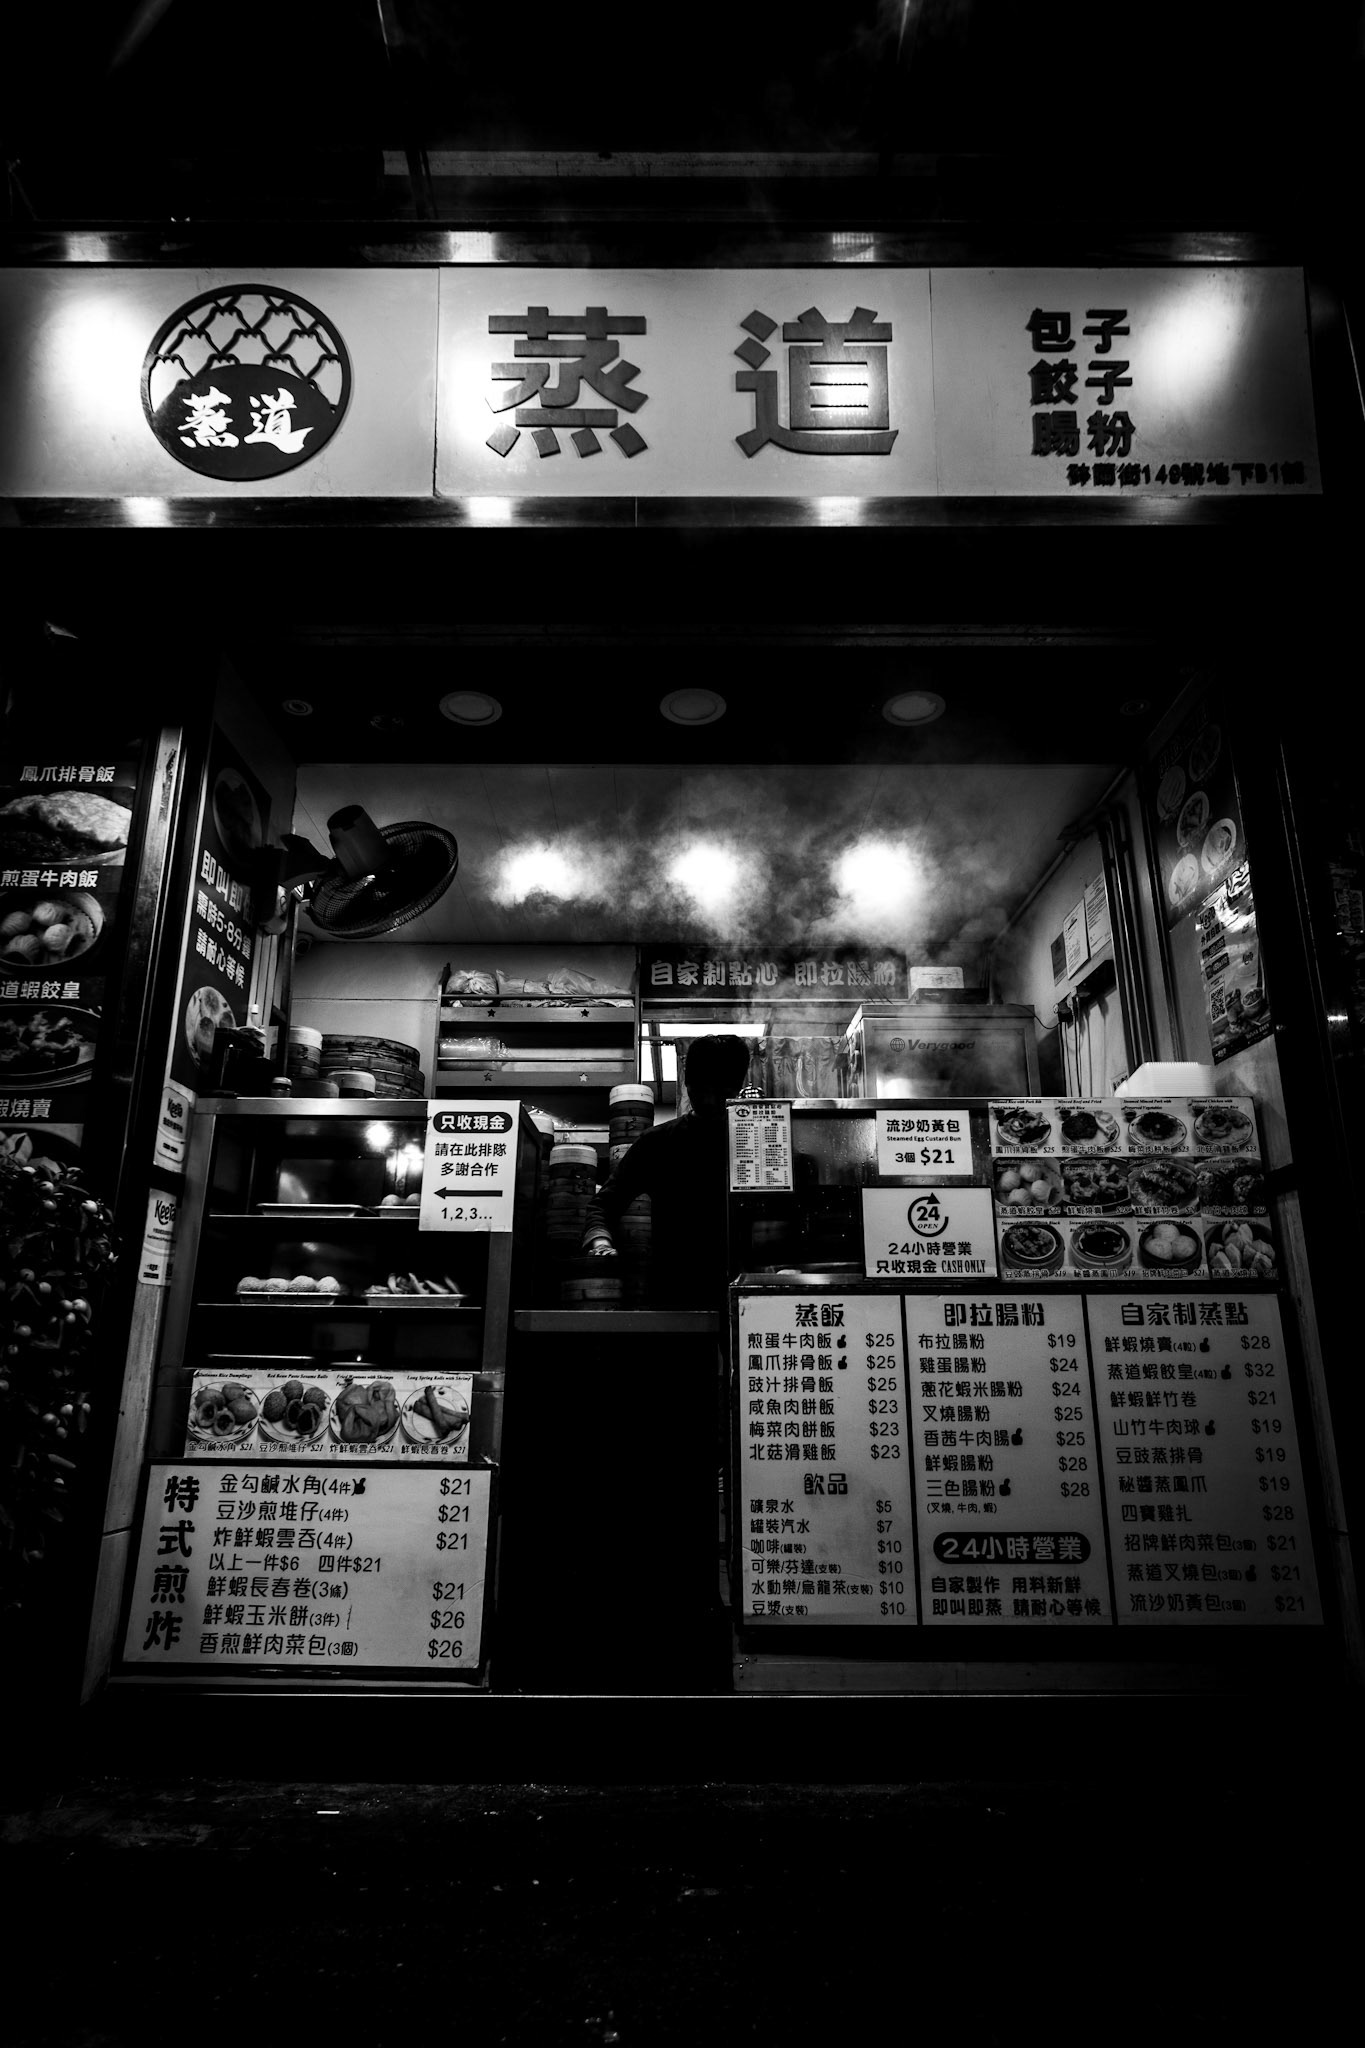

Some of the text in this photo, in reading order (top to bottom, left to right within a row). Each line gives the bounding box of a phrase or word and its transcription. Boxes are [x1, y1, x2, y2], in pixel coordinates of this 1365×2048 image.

[1026, 307, 1130, 354] 包子
[485, 306, 898, 456] 蒸道
[1027, 358, 1133, 407] 餃子
[178, 386, 314, 454] 蒸道
[1031, 410, 1136, 458] 腸粉
[20, 765, 116, 783] 鳳爪排骨飯
[0, 870, 99, 888] 煎蛋牛肉飯
[0, 981, 80, 999] 道蝦餃皇
[908, 1039, 975, 1051] Verygood
[440, 1114, 505, 1130] 只收現金
[886, 1119, 960, 1133] 流沙奶黃包
[434, 1143, 507, 1157] 請在此排隊
[895, 1147, 955, 1166] 3個 $21
[440, 1162, 499, 1177] 多謝合作
[916, 1206, 940, 1221] 24
[888, 1241, 972, 1256] 24小時營業
[876, 1260, 986, 1274] 只收現金 CASH ONLY
[796, 1303, 845, 1327] 蒸飯
[944, 1303, 1045, 1327] 即拉腸粉
[1121, 1302, 1249, 1326] 自家制蒸點
[747, 1333, 895, 1349] 煎蛋牛肉飯 $25
[918, 1333, 1076, 1350] 布拉腸粉 $19
[1240, 1335, 1271, 1350] $28
[748, 1354, 896, 1371] 鳳爪排骨飯 $25
[920, 1357, 1079, 1374] 雞蛋腸粉 $24
[1244, 1362, 1275, 1378] $32
[748, 1376, 897, 1393] 豉汁排骨飯 $25
[1052, 1382, 1081, 1397] $24
[749, 1399, 898, 1415] 咸魚肉餅飯 $23
[1110, 1390, 1276, 1408] 鮮蝦鮮竹卷 $21
[922, 1405, 1083, 1422] 叉燒腸粉 $25
[749, 1421, 899, 1438] 梅菜肉餅飯 $23
[1113, 1418, 1282, 1436] 山竹牛肉球 $19
[923, 1430, 1085, 1447] 香茜牛肉腸 $25
[749, 1443, 900, 1461] 北菇滑雞飯 $23
[1116, 1447, 1286, 1465] 豆豉蒸排骨 $19
[925, 1454, 1088, 1472] 鮮蝦腸粉 $28
[219, 1473, 471, 1497] 金勾鹹水角(4件) $21
[804, 1473, 848, 1495] 飲品
[926, 1479, 1090, 1498] 三色腸粉 $28
[1119, 1475, 1290, 1493] 秘醬蒸鳳爪 $19
[216, 1499, 470, 1523] 豆沙煎堆仔(4件) $21
[750, 1499, 892, 1514] 礦泉水 $5
[1121, 1504, 1294, 1522] 四寶雞扎 $28
[750, 1518, 893, 1534] 罐裝汽水 $7
[213, 1526, 468, 1551] 炸鮮蝦雲吞(4件) $21
[877, 1540, 902, 1554] $10
[1266, 1534, 1296, 1551] $21
[941, 1536, 1083, 1560] 24小時營業
[143, 1475, 200, 1651] 特式煎炸
[208, 1552, 382, 1574] 以上一件$6 四件$21
[751, 1559, 903, 1575] 可樂/芬達(支裝) $10
[1270, 1565, 1300, 1582] $21
[206, 1575, 466, 1601] 鮮蝦長春卷(3條) $21
[879, 1581, 904, 1595] $10
[931, 1576, 1082, 1594] 自家製作 用料新鮮
[880, 1601, 905, 1616] $10
[932, 1598, 1102, 1617] 即叫即蒸 請耐心等候
[1275, 1595, 1305, 1613] $21
[202, 1603, 465, 1630] 鮮蝦玉米餅(3件) $26
[199, 1632, 463, 1660] 香煎鮮肉菜包(3個) $26
